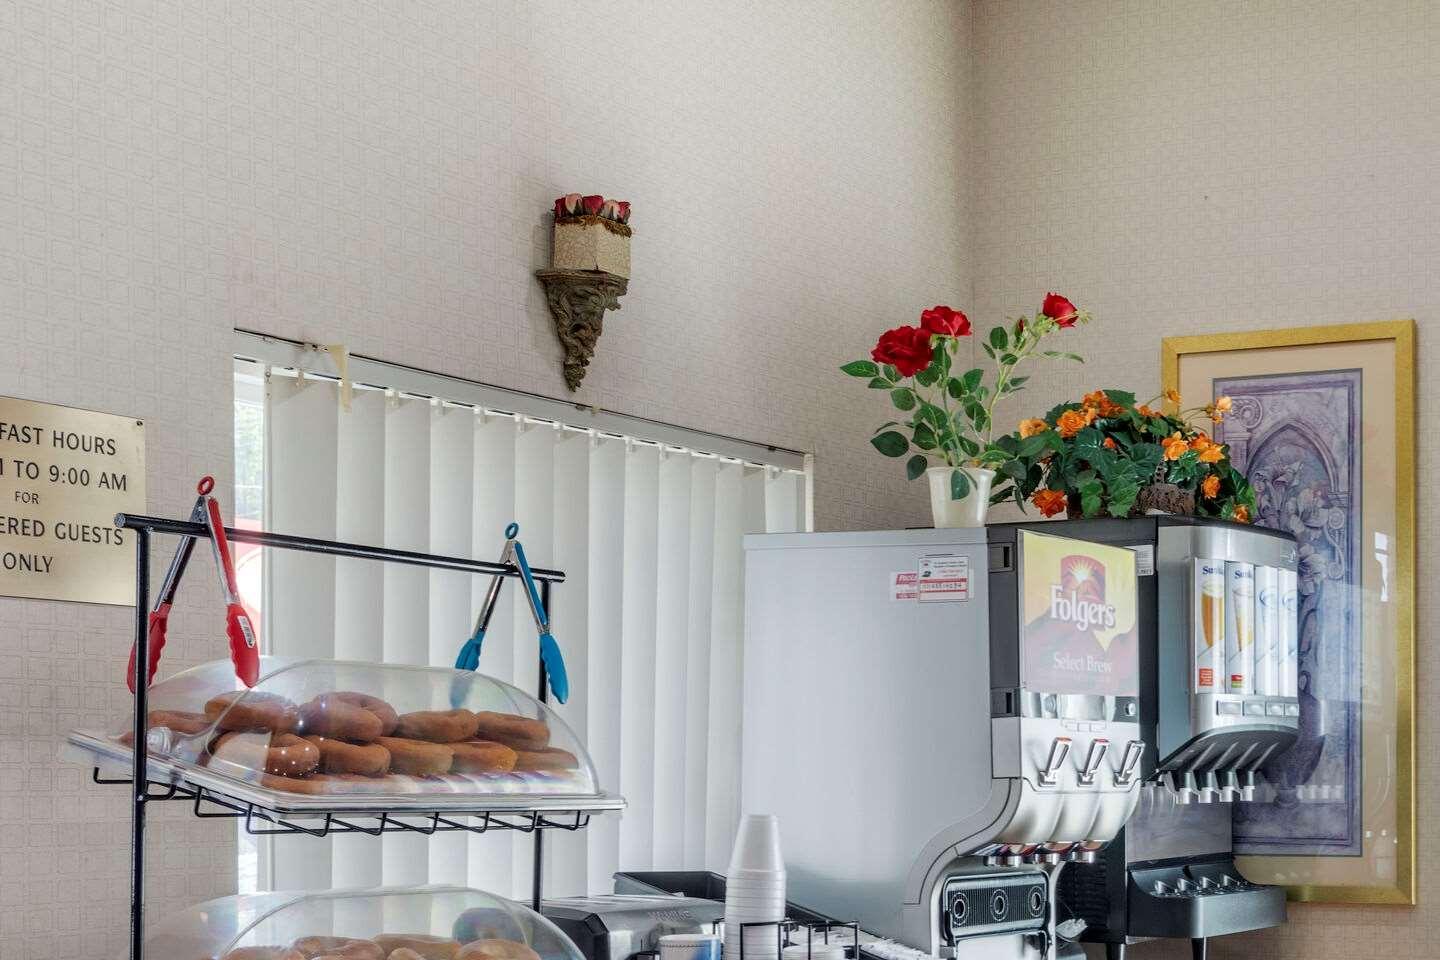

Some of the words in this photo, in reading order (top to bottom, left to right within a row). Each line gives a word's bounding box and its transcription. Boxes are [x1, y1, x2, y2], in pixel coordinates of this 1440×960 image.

[53, 429, 116, 456] HOURS
[13, 459, 40, 480] TO
[49, 464, 90, 487] 9:00
[98, 471, 127, 491] AM
[15, 490, 39, 505] FOR
[54, 522, 123, 546] GUESTS
[3, 552, 53, 573] ONLY
[1050, 584, 1116, 632] Folgers
[1053, 651, 1084, 672] Select
[1087, 655, 1113, 673] Brew
